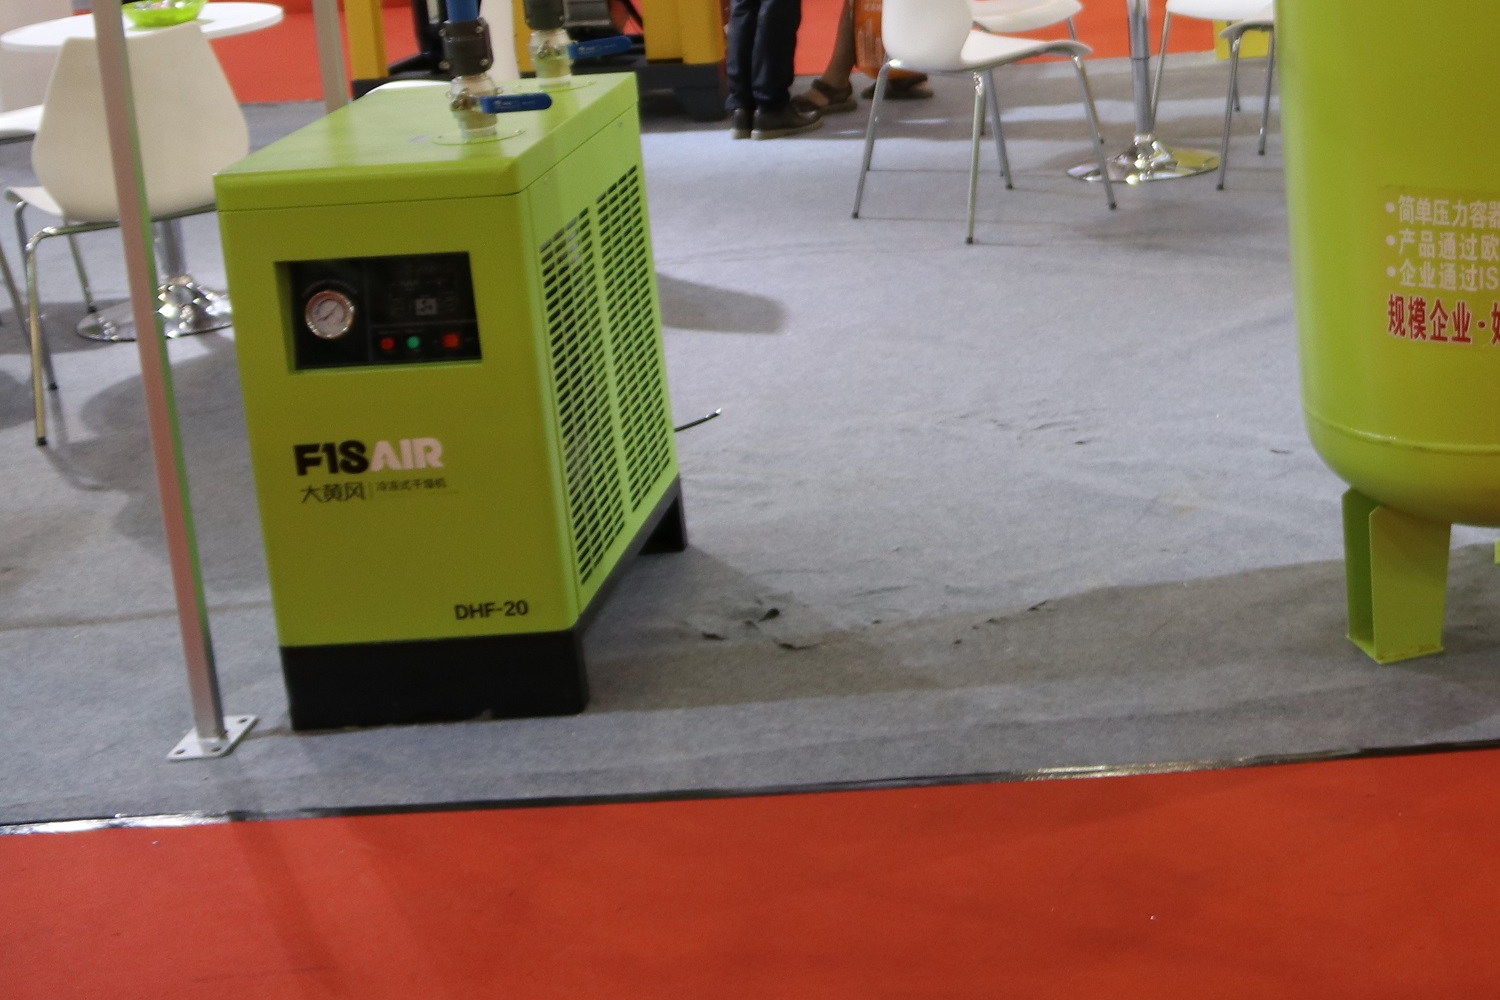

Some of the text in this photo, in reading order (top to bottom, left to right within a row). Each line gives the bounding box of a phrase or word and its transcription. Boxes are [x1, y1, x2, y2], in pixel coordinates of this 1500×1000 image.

[301, 481, 366, 504] 大黄风
[454, 600, 529, 620] DHF-20
